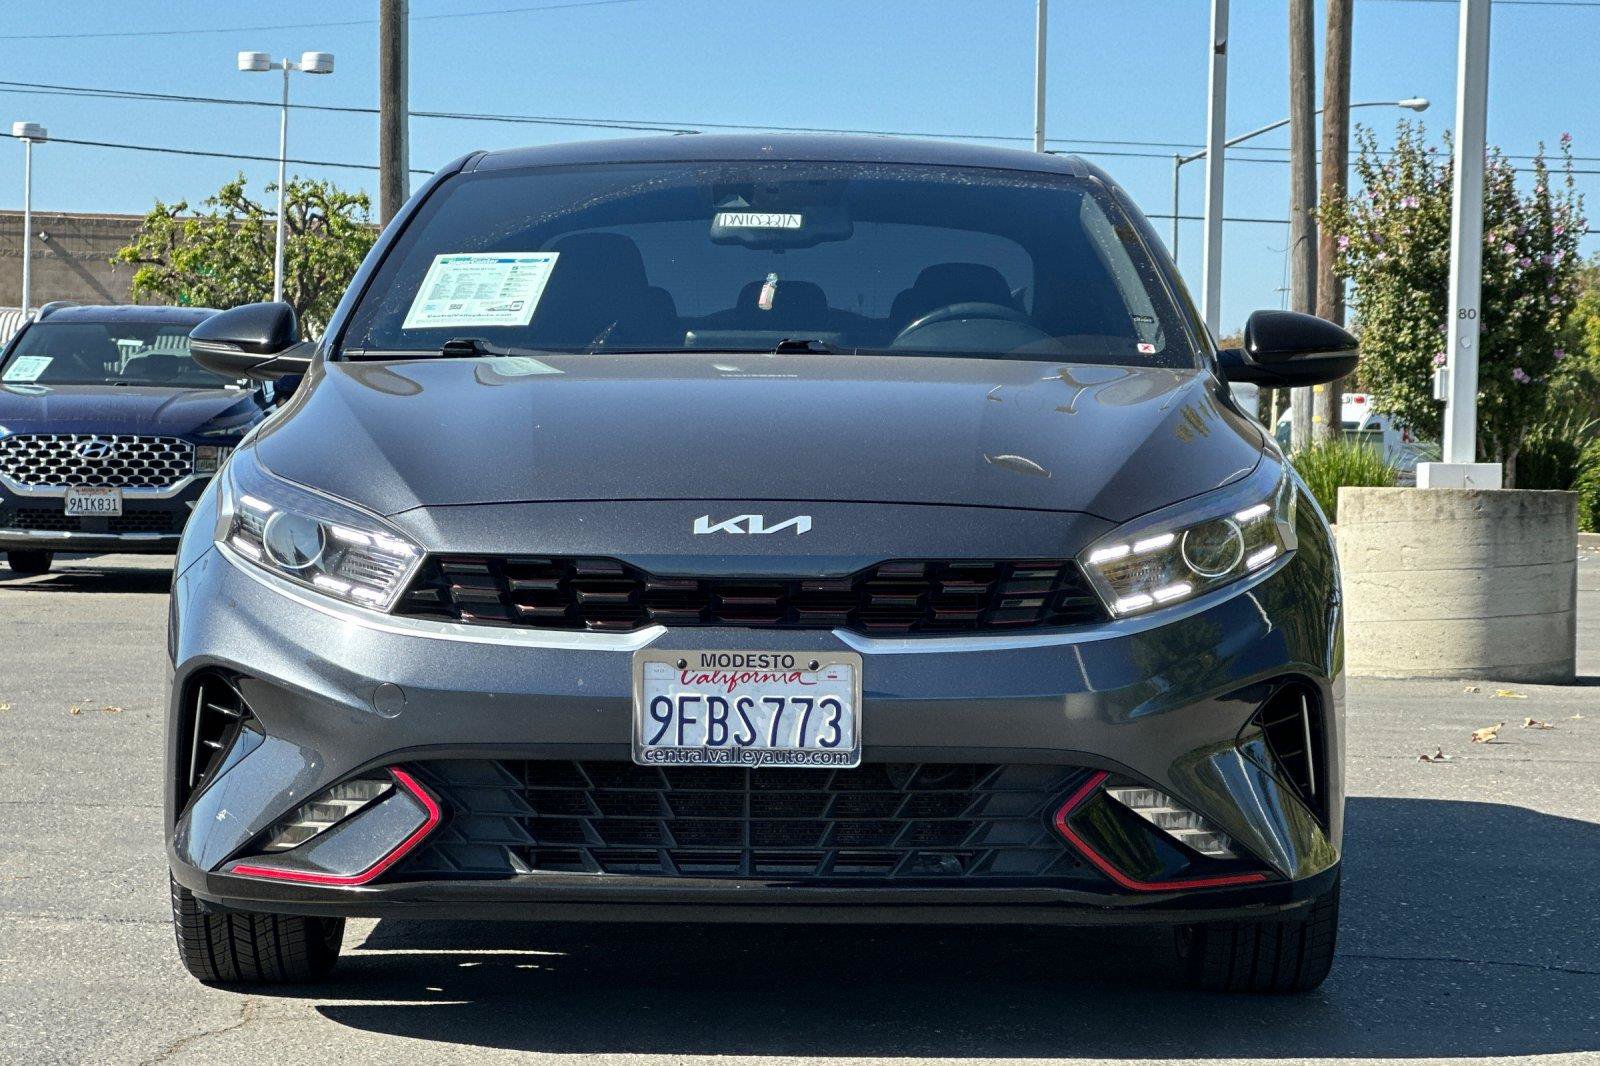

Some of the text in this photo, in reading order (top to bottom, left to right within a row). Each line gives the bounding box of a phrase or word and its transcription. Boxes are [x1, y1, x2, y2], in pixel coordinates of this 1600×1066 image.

[1458, 308, 1477, 320] 80
[70, 497, 118, 511] 9AIK831
[694, 514, 812, 535] KIA
[701, 653, 795, 668] MODESTO
[680, 669, 817, 694] California
[649, 695, 842, 748] 9FBS773
[644, 748, 850, 768] centralvalleyauto.com
